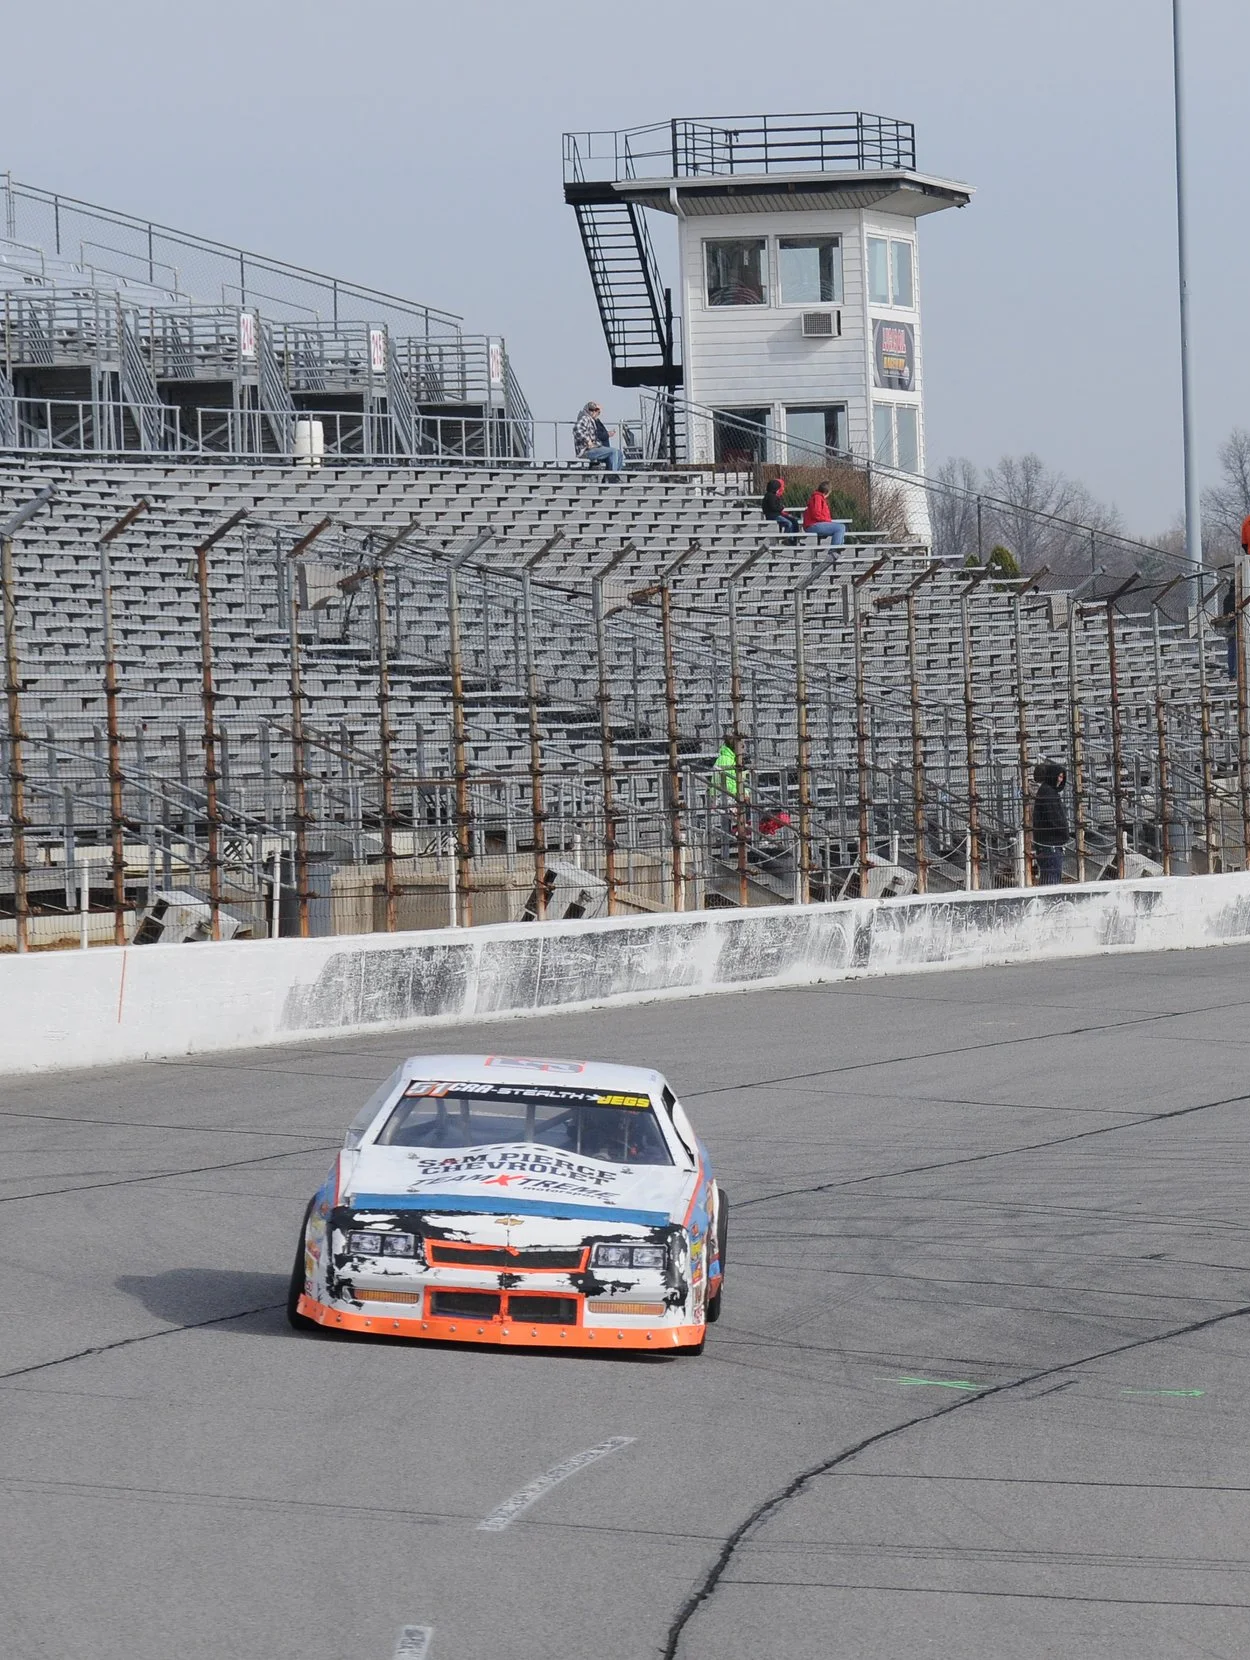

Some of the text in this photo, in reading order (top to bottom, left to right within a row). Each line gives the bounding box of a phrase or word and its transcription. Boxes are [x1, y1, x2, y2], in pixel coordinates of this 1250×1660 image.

[596, 1095, 650, 1108] JEGS
[418, 1152, 617, 1181] SAM PIERCE
[421, 1161, 610, 1186] CHEVROLET
